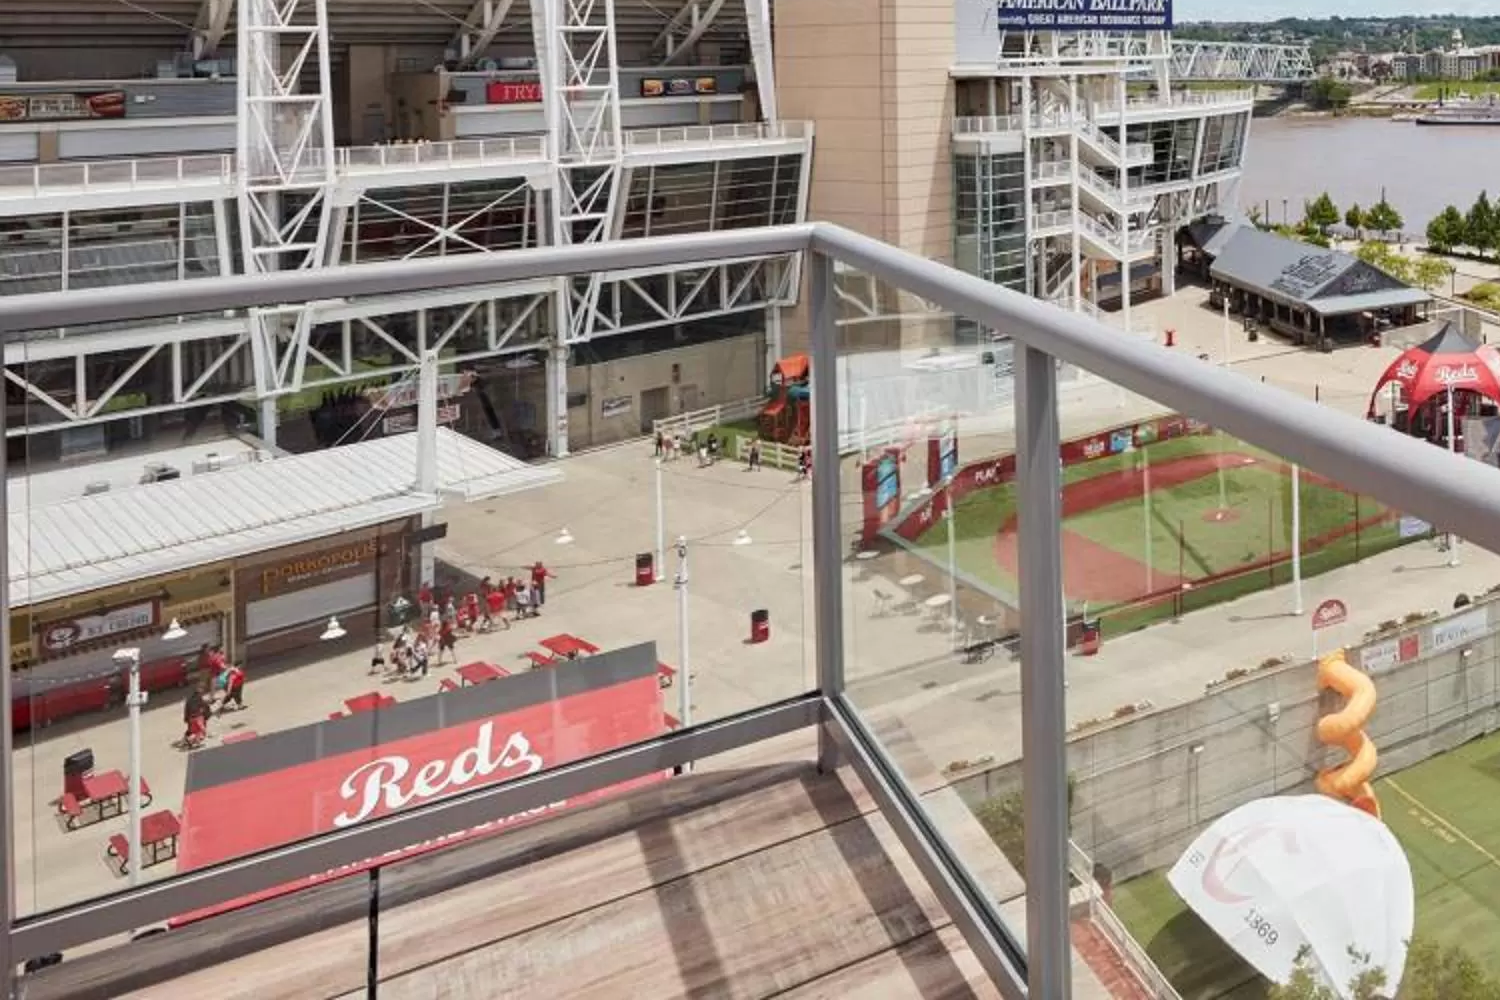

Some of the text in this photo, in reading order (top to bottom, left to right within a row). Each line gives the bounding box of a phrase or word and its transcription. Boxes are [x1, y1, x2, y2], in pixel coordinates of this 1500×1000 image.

[1028, 13, 1055, 25] GREAT
[503, 84, 542, 101] FRY
[1435, 362, 1478, 382] Reds
[333, 720, 543, 828] Reds
